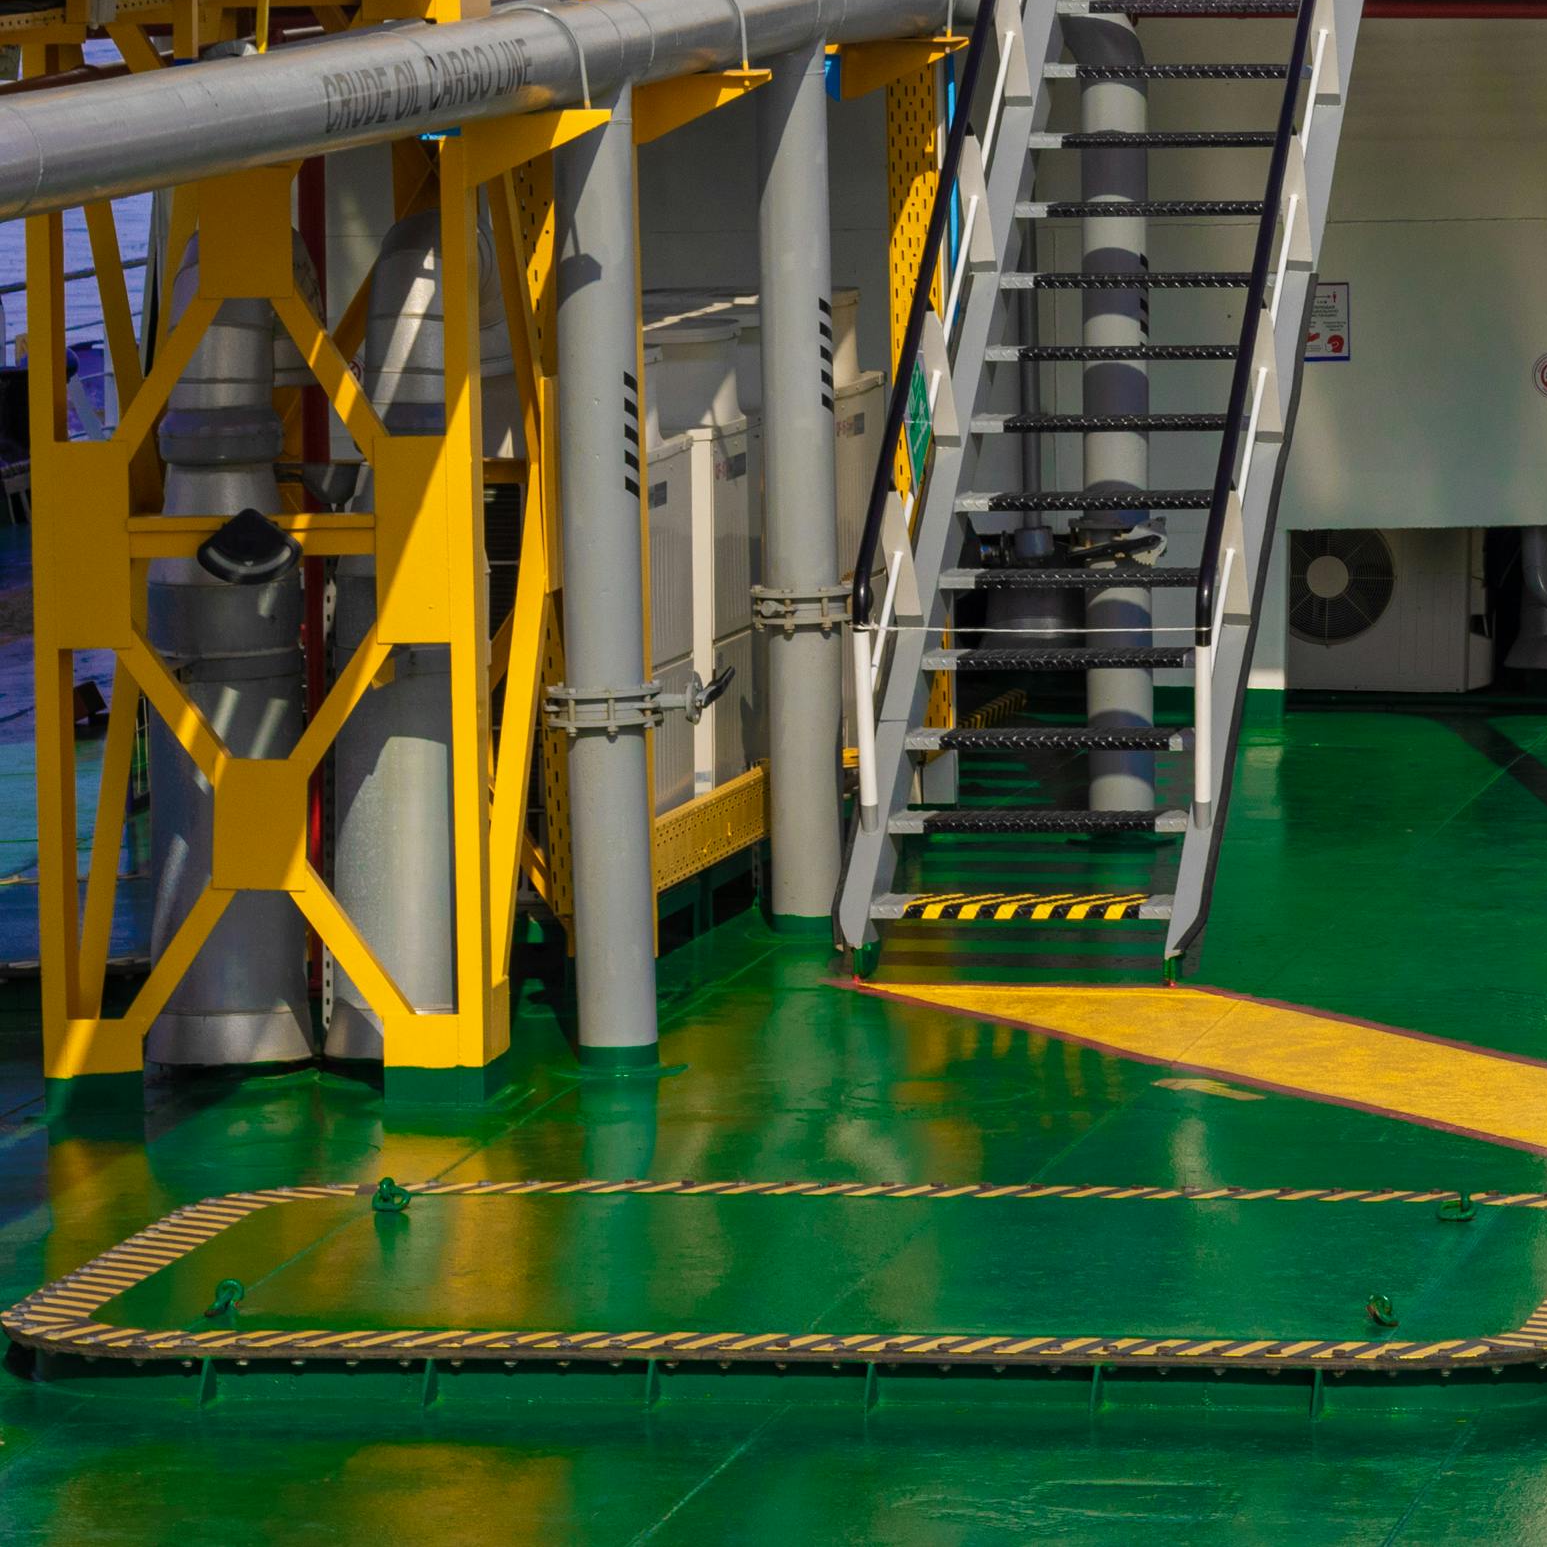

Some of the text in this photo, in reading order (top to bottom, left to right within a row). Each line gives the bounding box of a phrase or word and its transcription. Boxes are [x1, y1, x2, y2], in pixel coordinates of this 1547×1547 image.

[322, 38, 533, 134] CRUDE OIL CARGO LINE
